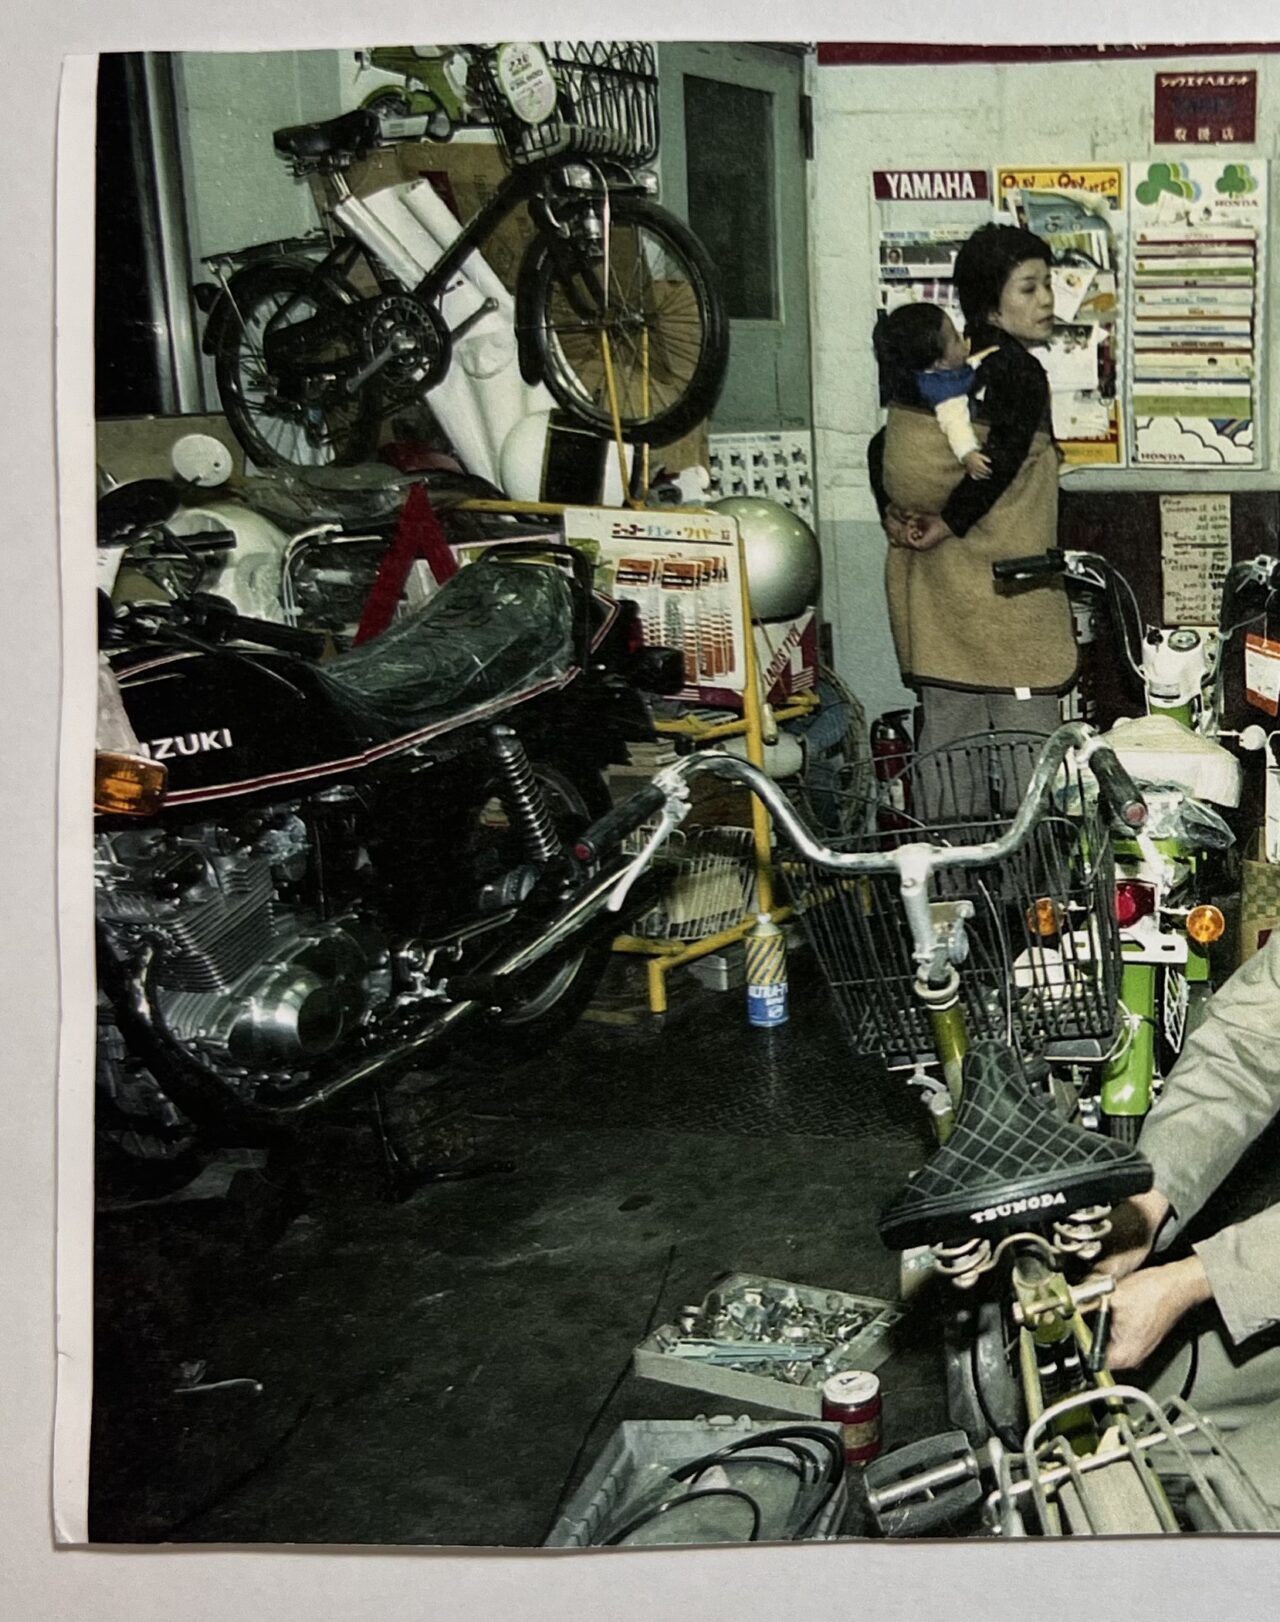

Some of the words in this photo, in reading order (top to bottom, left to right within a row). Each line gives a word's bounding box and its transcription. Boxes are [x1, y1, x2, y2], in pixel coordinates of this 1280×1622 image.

[886, 172, 976, 199] YAMAHA
[1214, 199, 1259, 208] HONDA
[1140, 452, 1186, 461] HONDA
[141, 728, 233, 760] ZUKI
[969, 1191, 1067, 1224] TSUNODA
